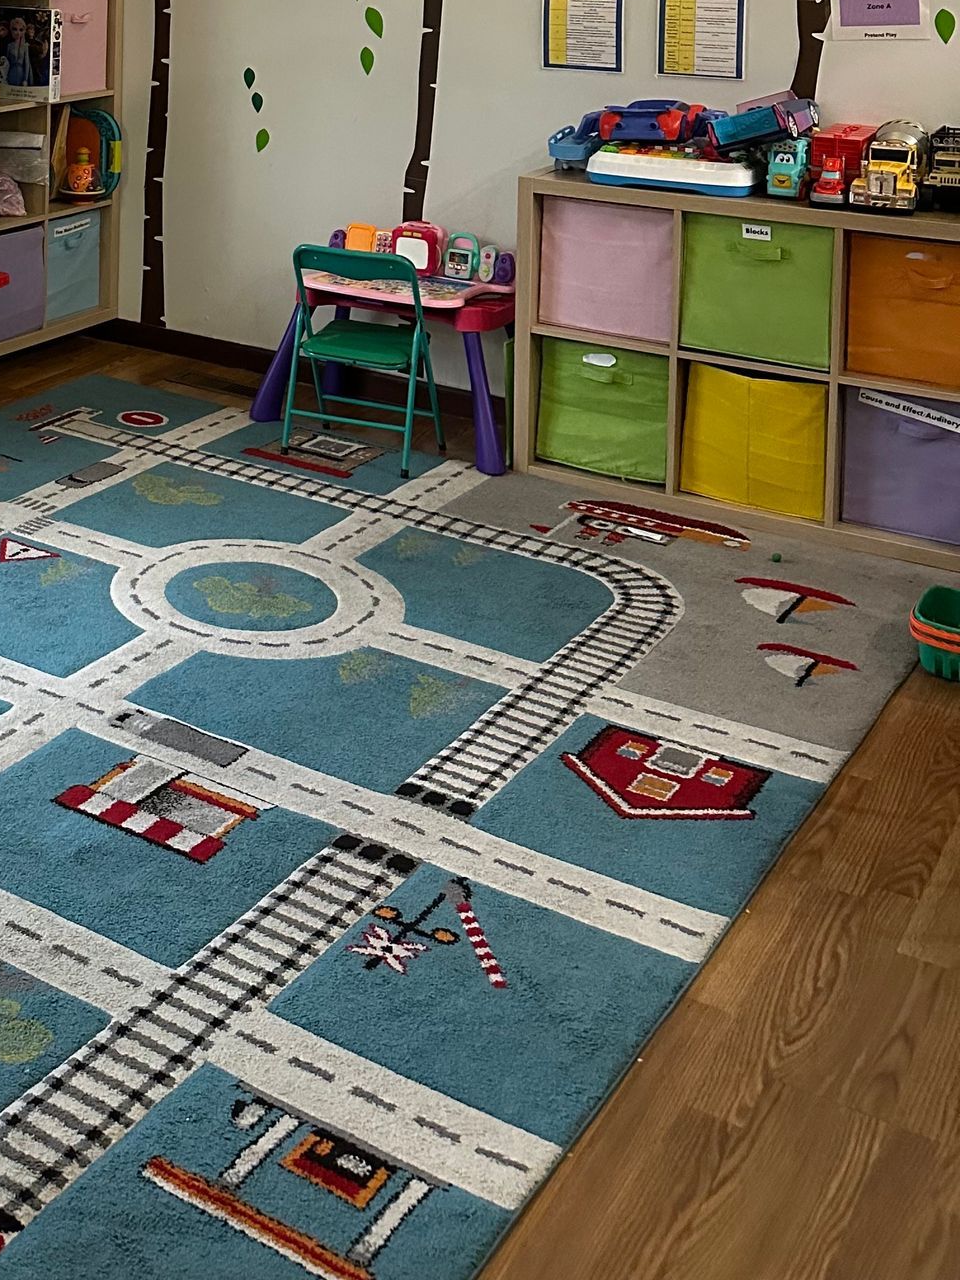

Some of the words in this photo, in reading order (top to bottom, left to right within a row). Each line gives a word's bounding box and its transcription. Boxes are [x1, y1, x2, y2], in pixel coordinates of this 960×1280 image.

[745, 227, 769, 236] Blocks
[860, 392, 883, 405] Cause
[884, 401, 900, 410] and
